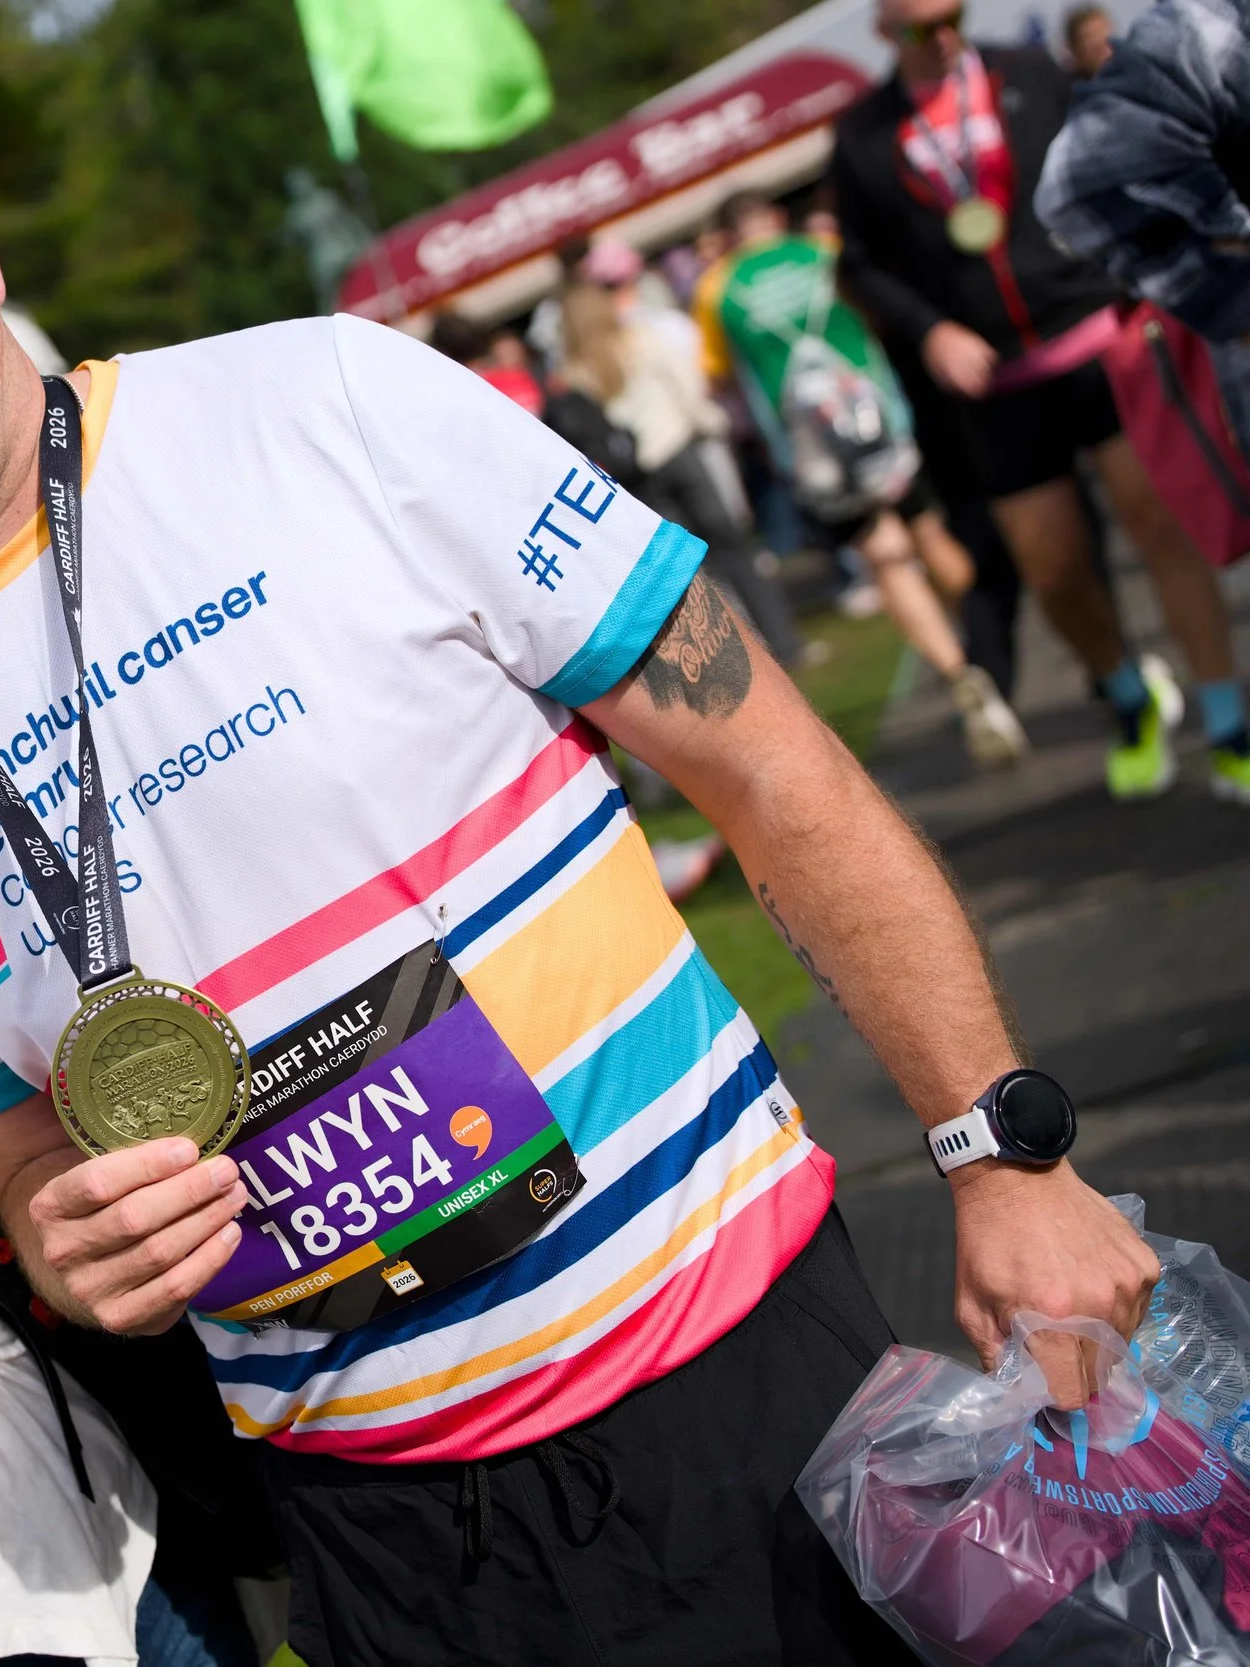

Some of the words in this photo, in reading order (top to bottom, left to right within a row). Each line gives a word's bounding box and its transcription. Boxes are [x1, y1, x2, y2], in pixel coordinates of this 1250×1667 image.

[48, 407, 67, 448] 2026
[49, 477, 68, 522] HALF
[56, 523, 76, 595] CARDIFF
[117, 571, 268, 686] canser
[82, 747, 93, 802] 2026
[129, 685, 307, 816] research
[24, 837, 60, 877] 2026
[83, 844, 99, 893] HALF
[97, 835, 109, 885] CAERDYDD
[101, 885, 116, 934] MARATHON
[86, 896, 106, 975] CARDIFF
[107, 932, 119, 971] HANNER
[307, 1000, 373, 1057] HALF
[266, 1062, 330, 1109] MARATHON
[329, 1025, 388, 1068] CAERDYDD
[455, 1115, 486, 1138] Cymraeg
[261, 1133, 453, 1271] 18354
[438, 1180, 490, 1218] UNISEX
[487, 1169, 509, 1187] XL
[534, 1175, 552, 1192] SUPER
[249, 1297, 277, 1313] PEN
[274, 1271, 335, 1303] PORFFOR
[391, 1272, 417, 1291] 2026
